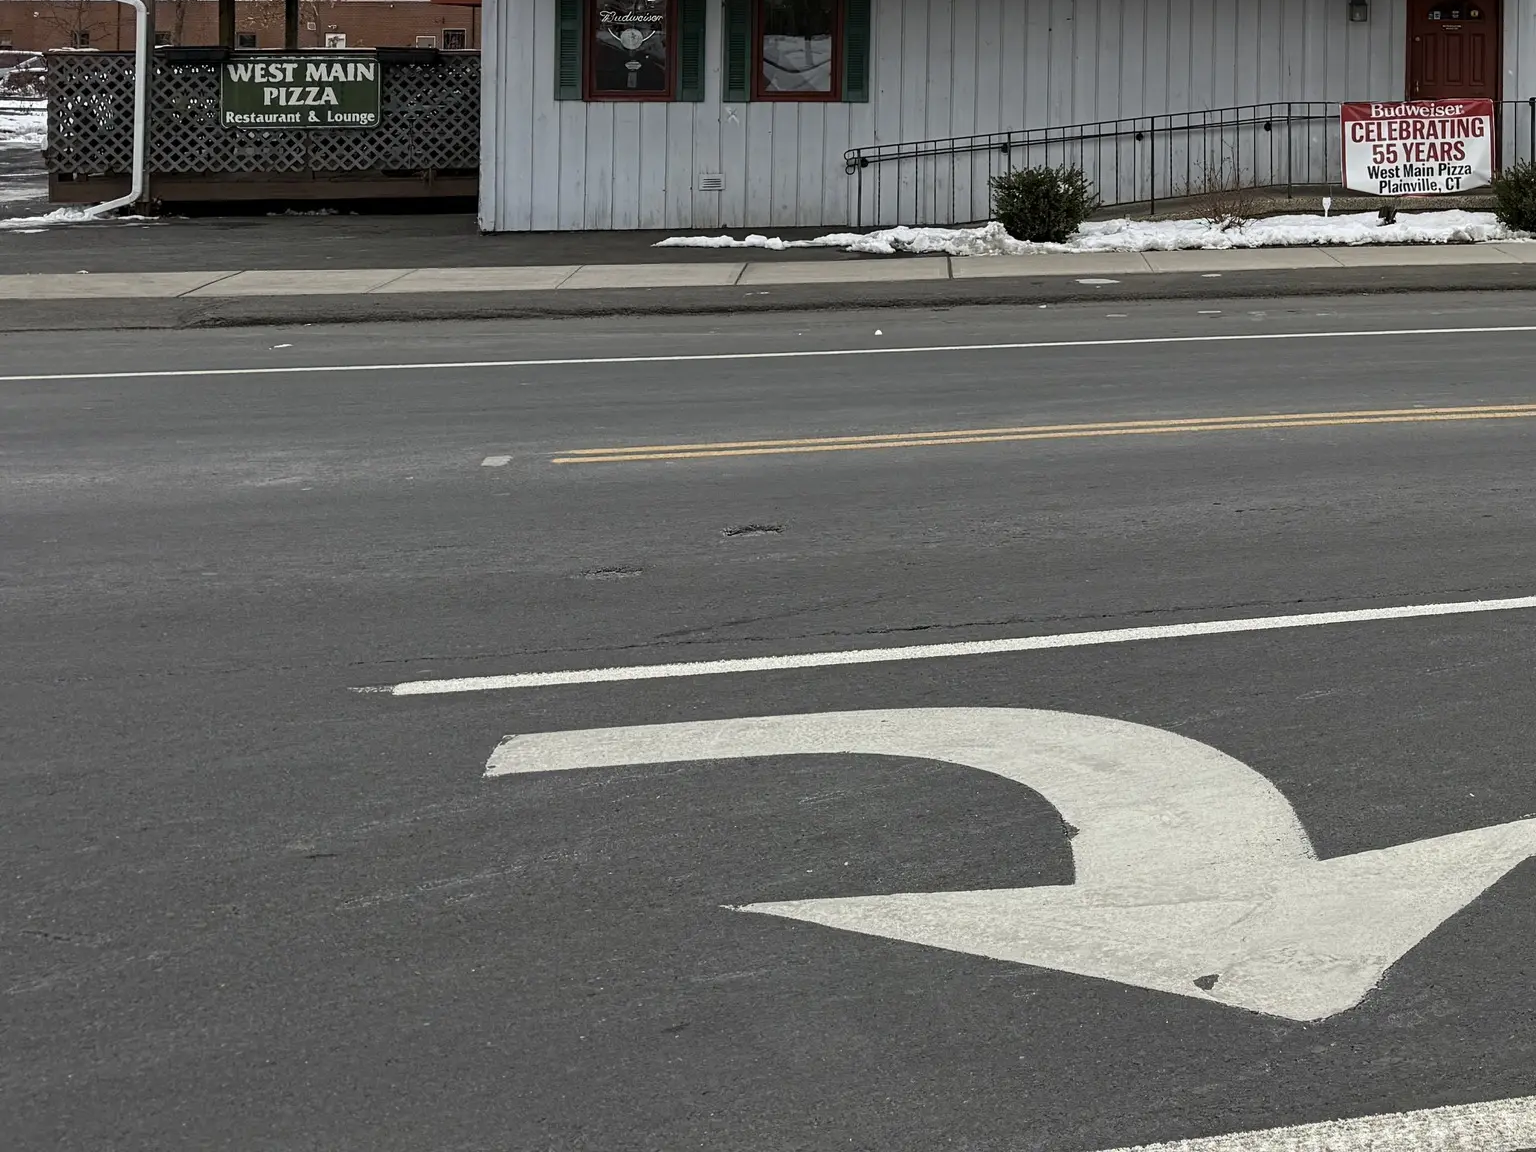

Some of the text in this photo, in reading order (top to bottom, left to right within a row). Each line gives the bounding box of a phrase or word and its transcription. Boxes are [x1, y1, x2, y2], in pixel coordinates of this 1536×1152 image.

[600, 11, 663, 23] Budweiser
[226, 63, 375, 83] WEST MAIN
[263, 87, 339, 106] PIZZA
[225, 110, 375, 125] Restaurant & Lounge
[1370, 102, 1464, 118] Budweiser
[1351, 117, 1484, 143] CELEBRATING
[1372, 140, 1466, 165] 55 YEARS
[1367, 162, 1472, 179] West Main Pizza
[1379, 176, 1462, 194] Plainville, CT
